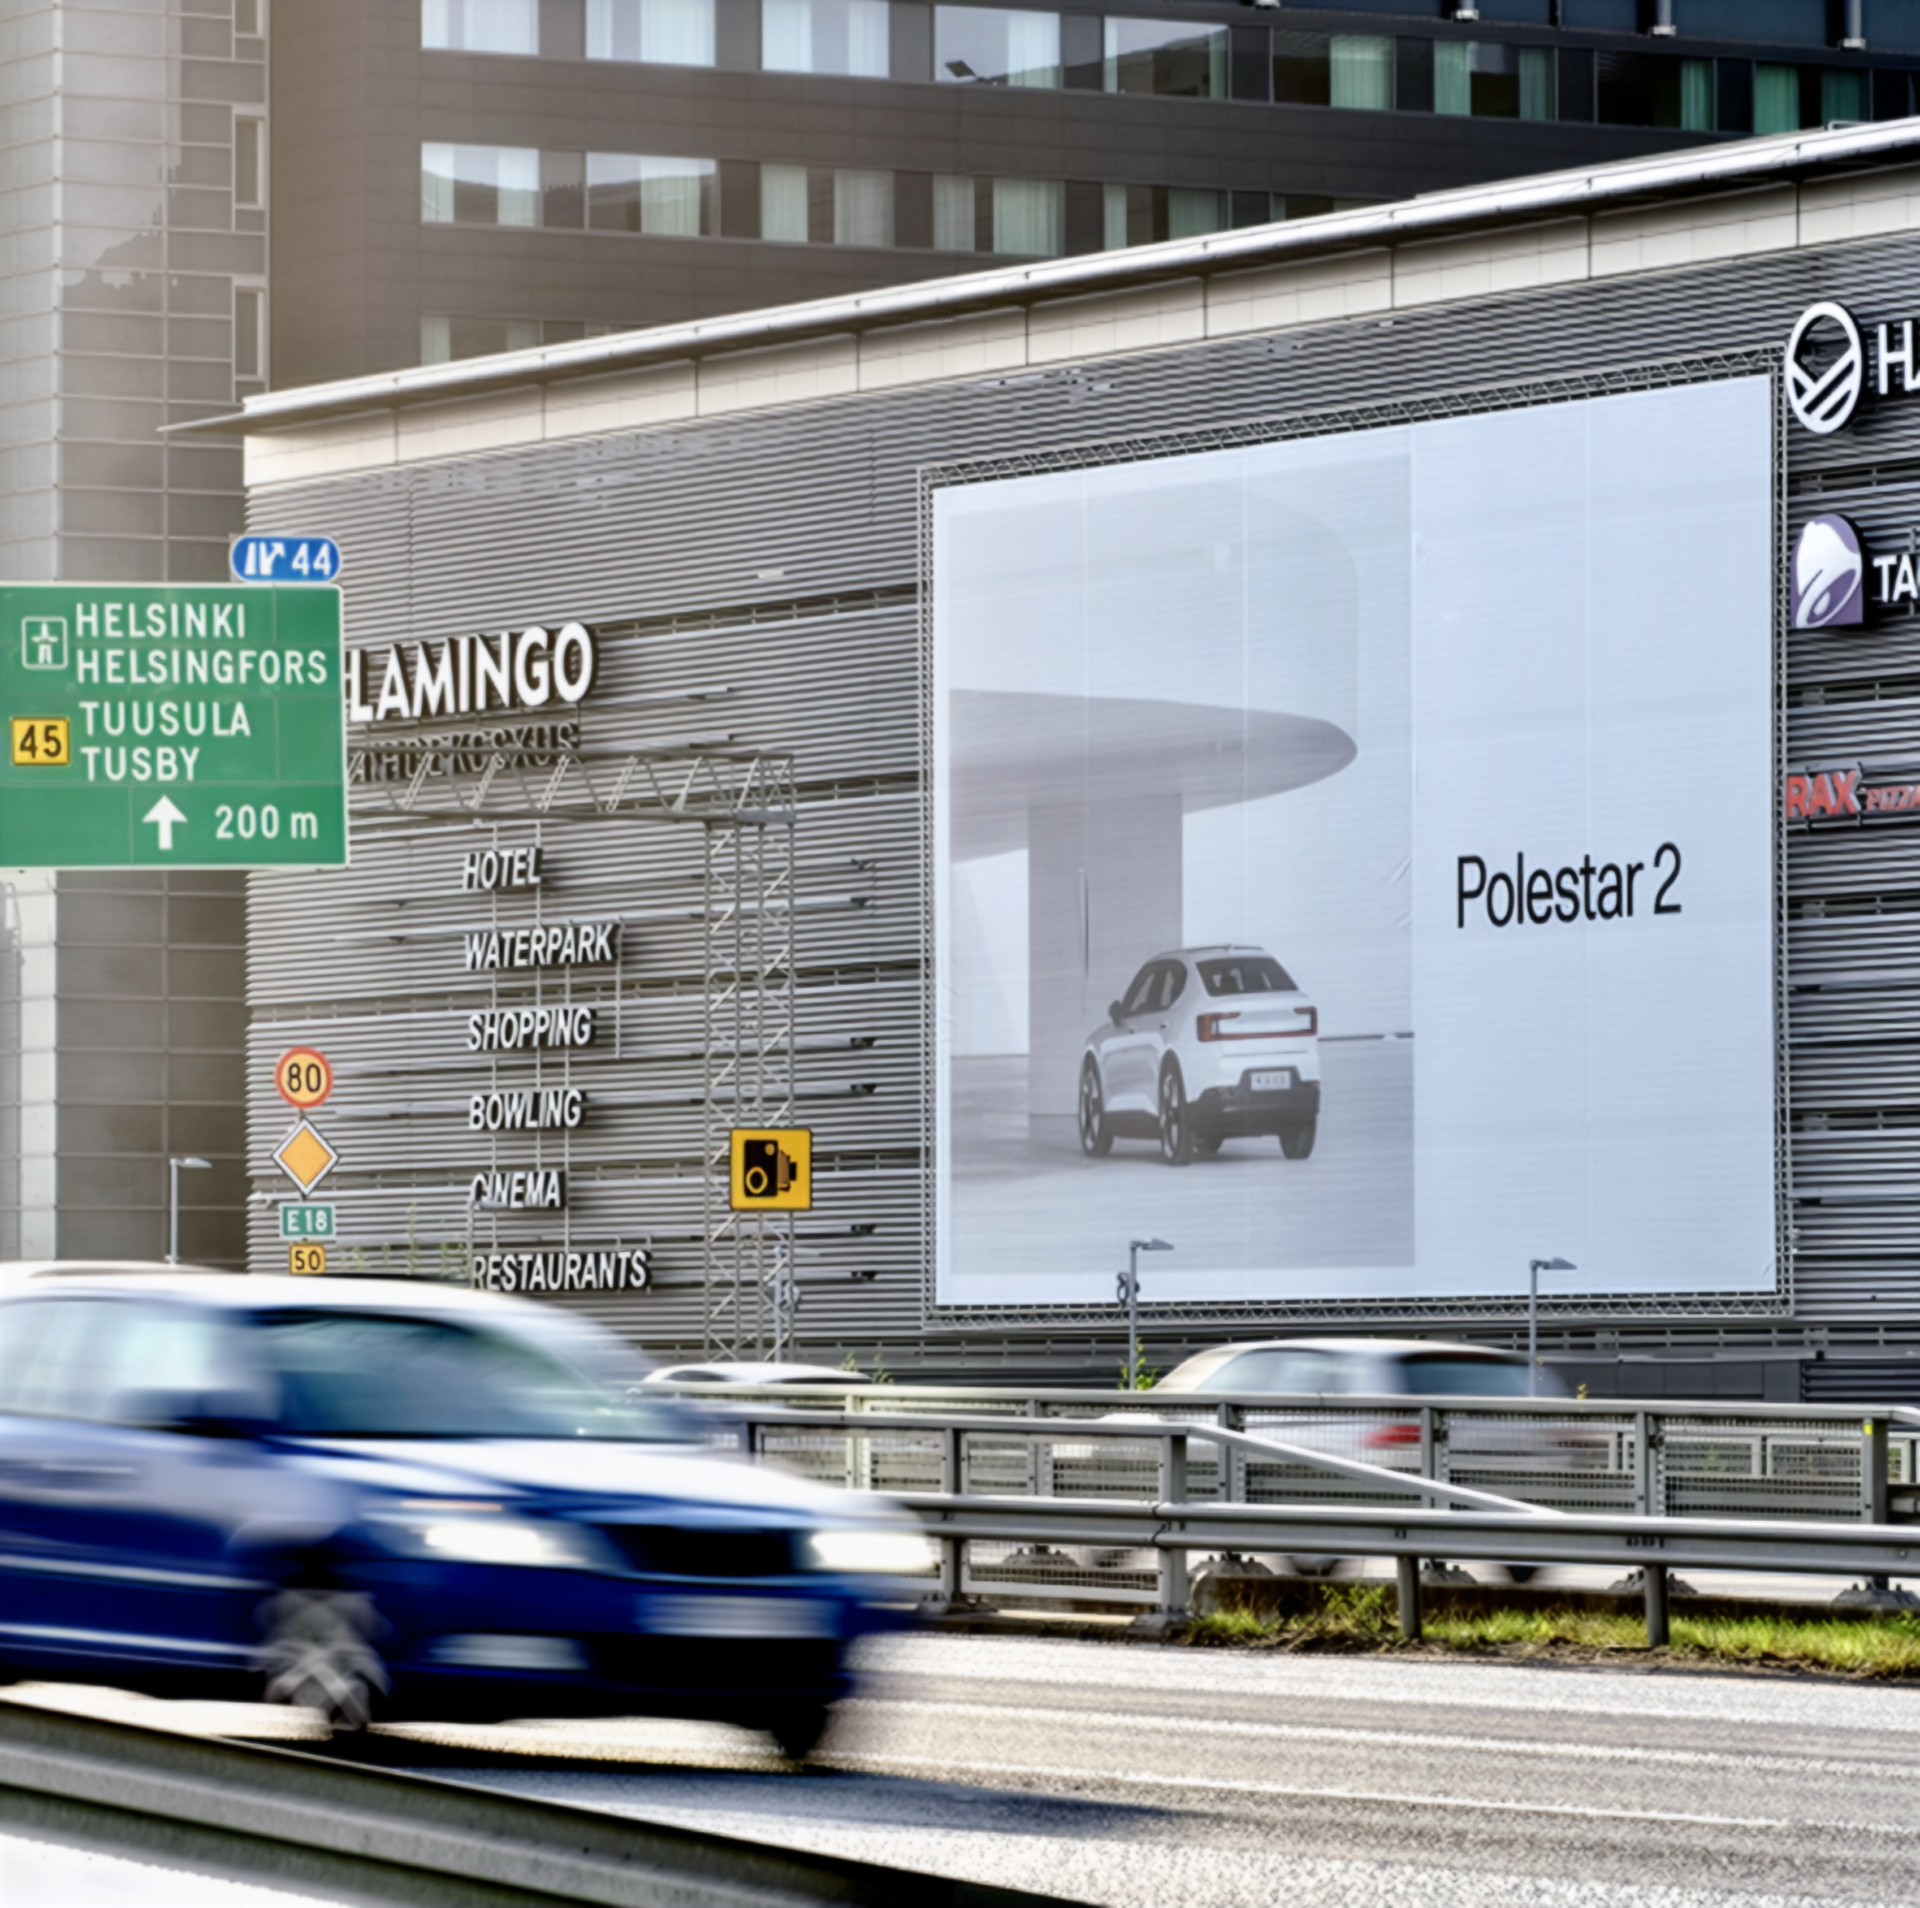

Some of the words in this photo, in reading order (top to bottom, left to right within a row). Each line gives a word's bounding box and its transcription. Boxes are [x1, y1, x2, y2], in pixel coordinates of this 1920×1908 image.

[1878, 320, 1920, 395] H
[291, 542, 332, 576] 44
[76, 602, 245, 638] HELSINKI
[77, 649, 328, 684] HELSINGFORS
[345, 622, 593, 722] LAMINGO
[79, 701, 251, 737] TUUSULA
[19, 724, 62, 759] 45
[80, 746, 200, 782] TUSBY
[1787, 769, 1857, 818] RAX
[215, 805, 279, 839] 200
[291, 811, 318, 839] m
[463, 847, 541, 890] HOTEL
[1457, 851, 1644, 929] Polestar
[1653, 841, 1682, 915] 2
[464, 923, 614, 971] WATERPARK
[467, 1007, 591, 1051] SHOPPING
[287, 1062, 322, 1093] 80
[468, 1088, 583, 1131] BOWLING
[469, 1170, 561, 1211] CINEMA
[294, 1249, 321, 1271] 50
[471, 1250, 647, 1292] RESTAURANTS
